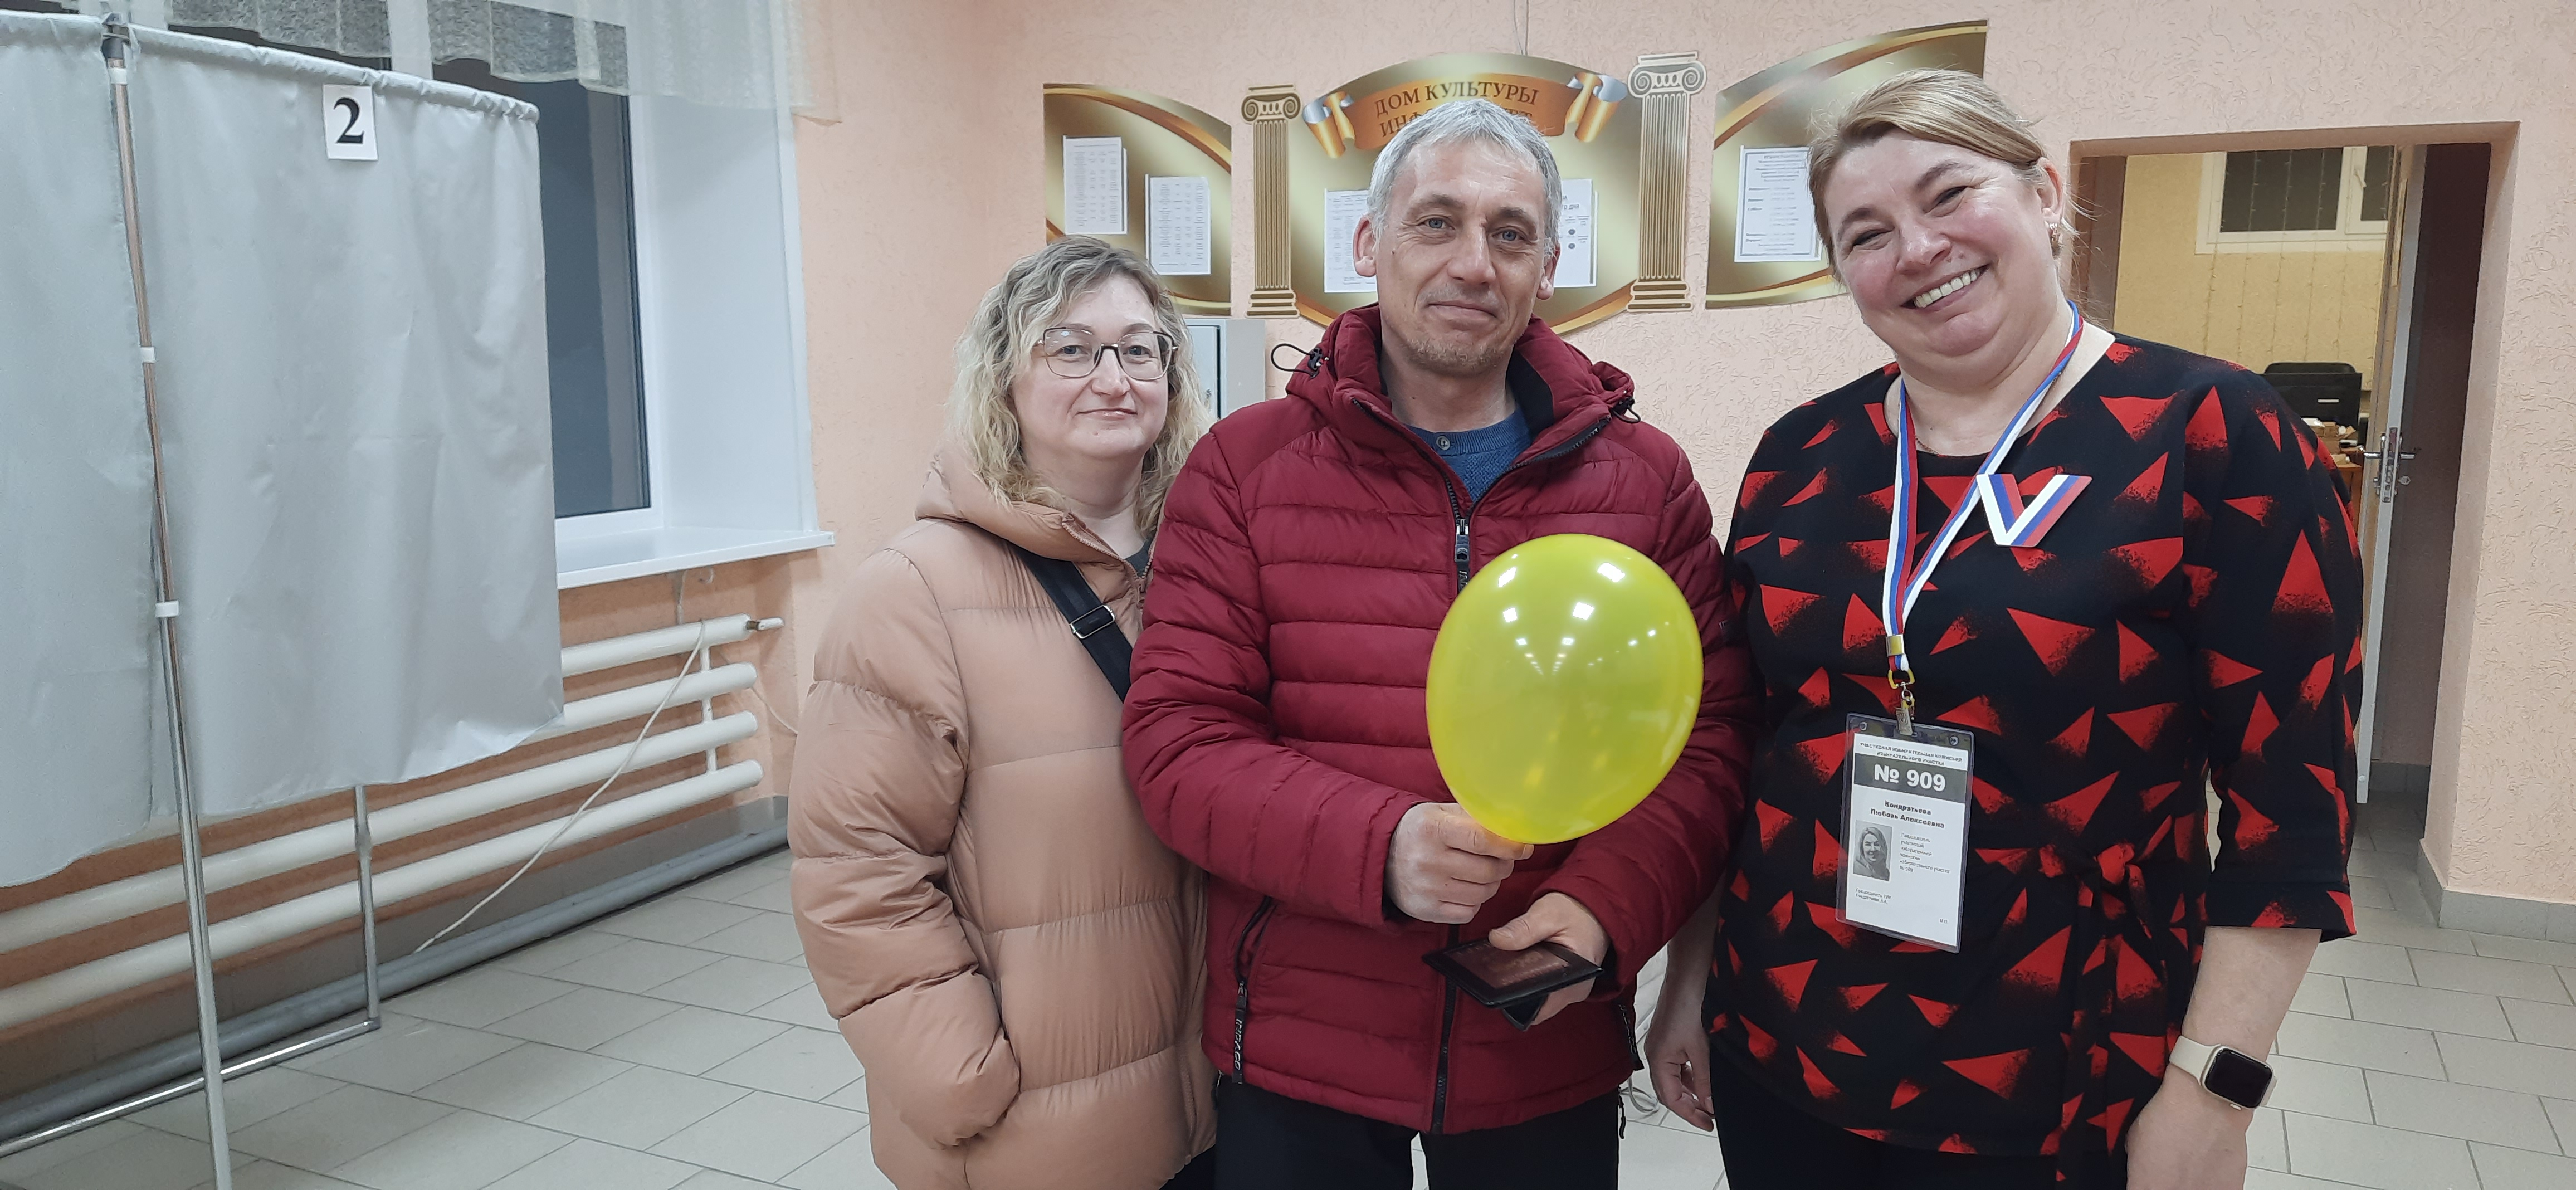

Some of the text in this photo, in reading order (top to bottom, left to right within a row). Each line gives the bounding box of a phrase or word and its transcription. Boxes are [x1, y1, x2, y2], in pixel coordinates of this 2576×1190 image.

[1374, 81, 1539, 118] ДОМ КУЛЬТУРЫ
[333, 97, 365, 144] 2
[1874, 764, 1946, 792] № 909
[1870, 808, 1945, 828] Любовь Алексеевна
[1885, 800, 1931, 816] Кондратьева
